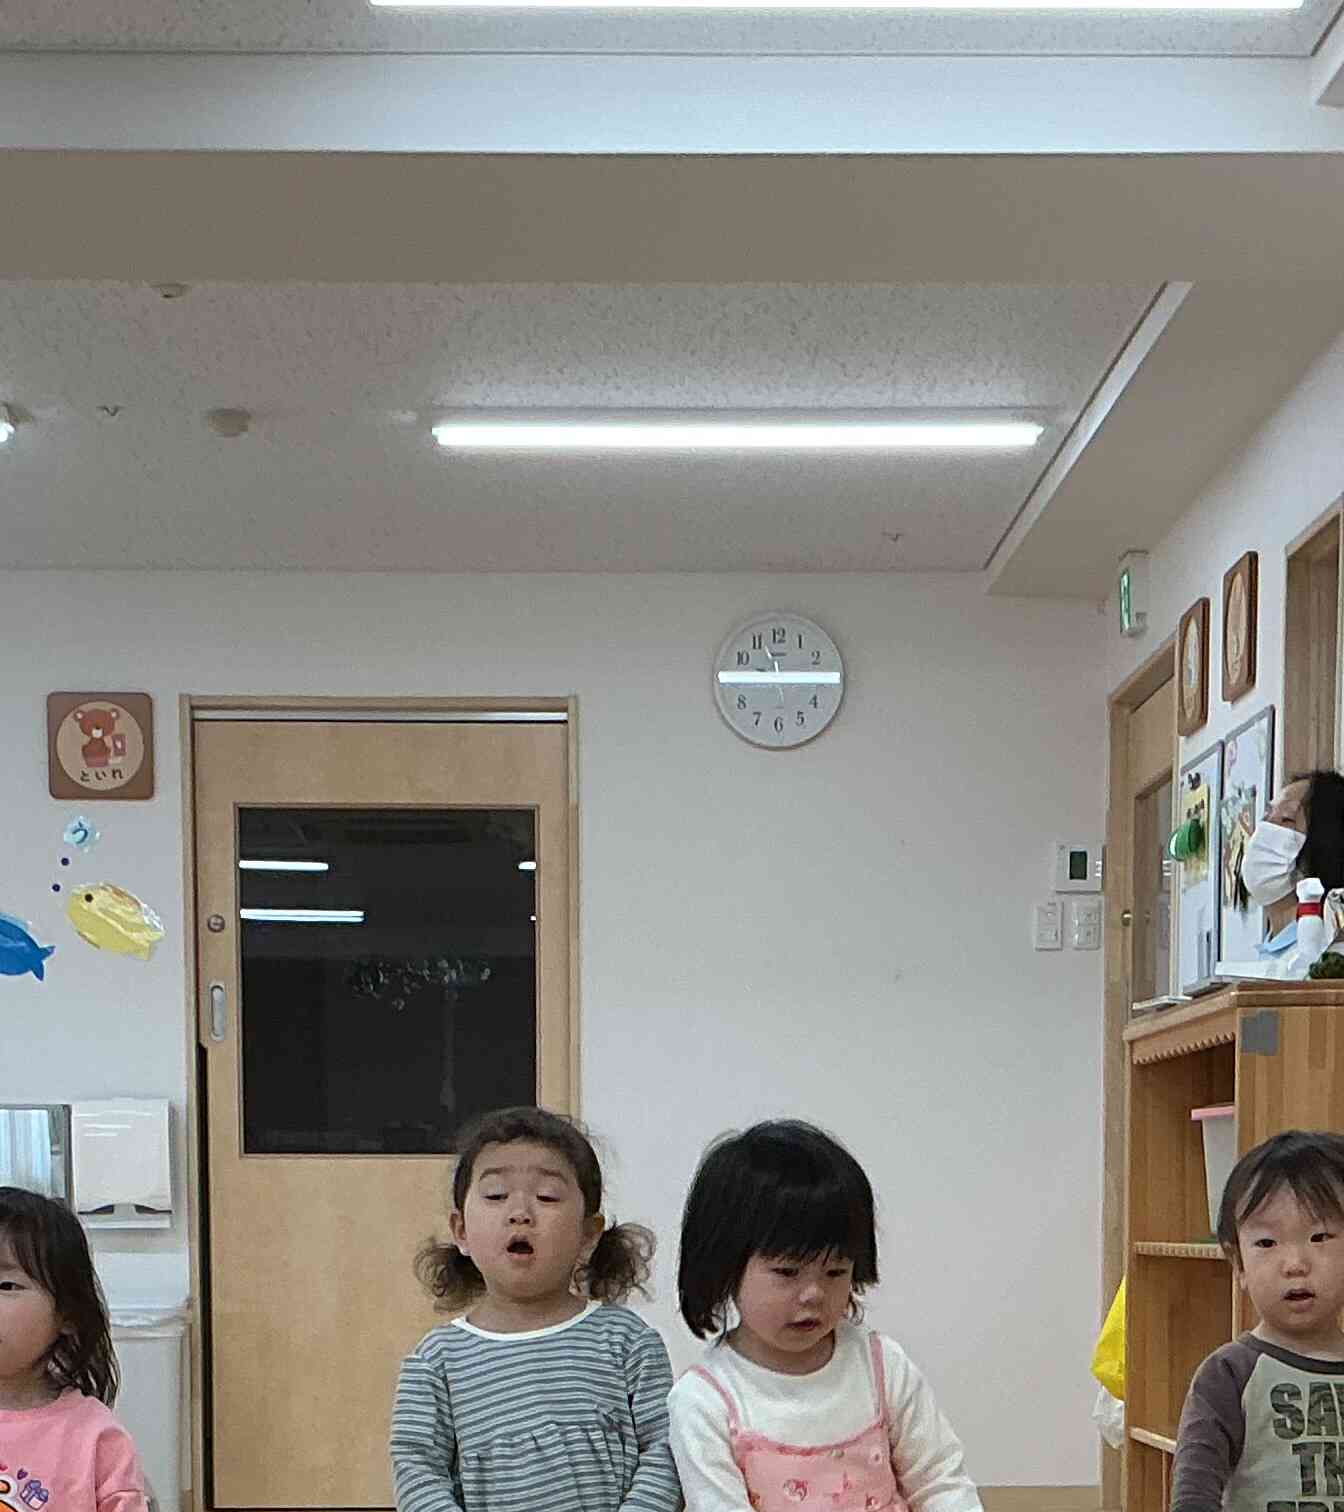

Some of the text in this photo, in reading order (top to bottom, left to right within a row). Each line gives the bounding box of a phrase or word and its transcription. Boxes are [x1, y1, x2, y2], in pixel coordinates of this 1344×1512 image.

[751, 634, 763, 650] 11
[771, 627, 786, 644] 12
[797, 634, 803, 649] 1
[736, 651, 750, 666] 10
[811, 651, 821, 665] 2
[736, 694, 747, 710] 8
[809, 694, 819, 709] 4
[752, 711, 762, 727] 7
[774, 717, 784, 733] 6
[795, 711, 805, 726] 5
[80, 767, 124, 783] といれ
[71, 821, 89, 844] う
